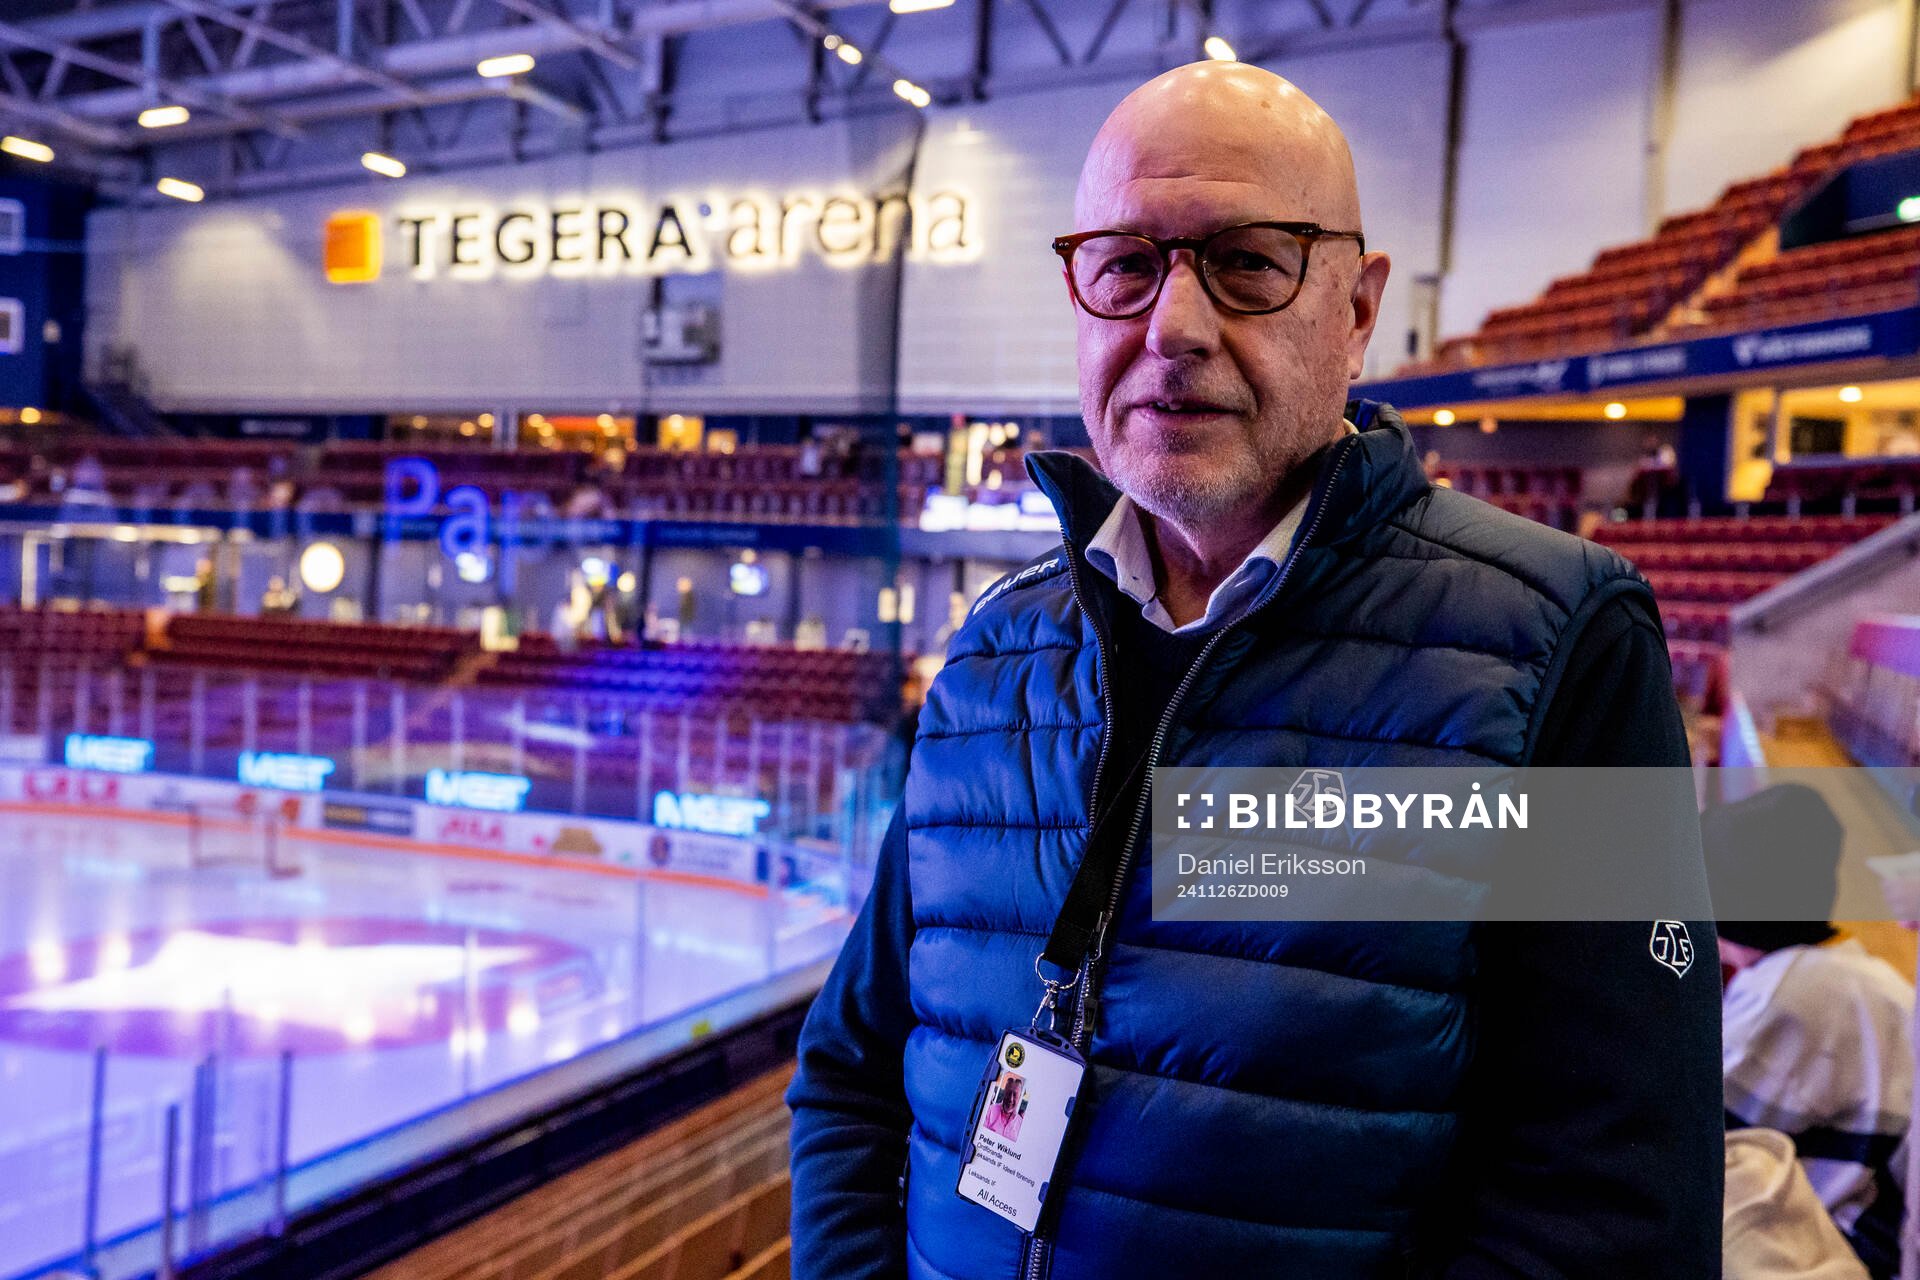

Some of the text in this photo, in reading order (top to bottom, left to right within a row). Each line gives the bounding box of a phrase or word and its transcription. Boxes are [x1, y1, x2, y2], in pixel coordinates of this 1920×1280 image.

[400, 188, 976, 268] TEGERA arena
[979, 1134, 1022, 1160] Peter Wiklund
[977, 1188, 1017, 1217] All Access
